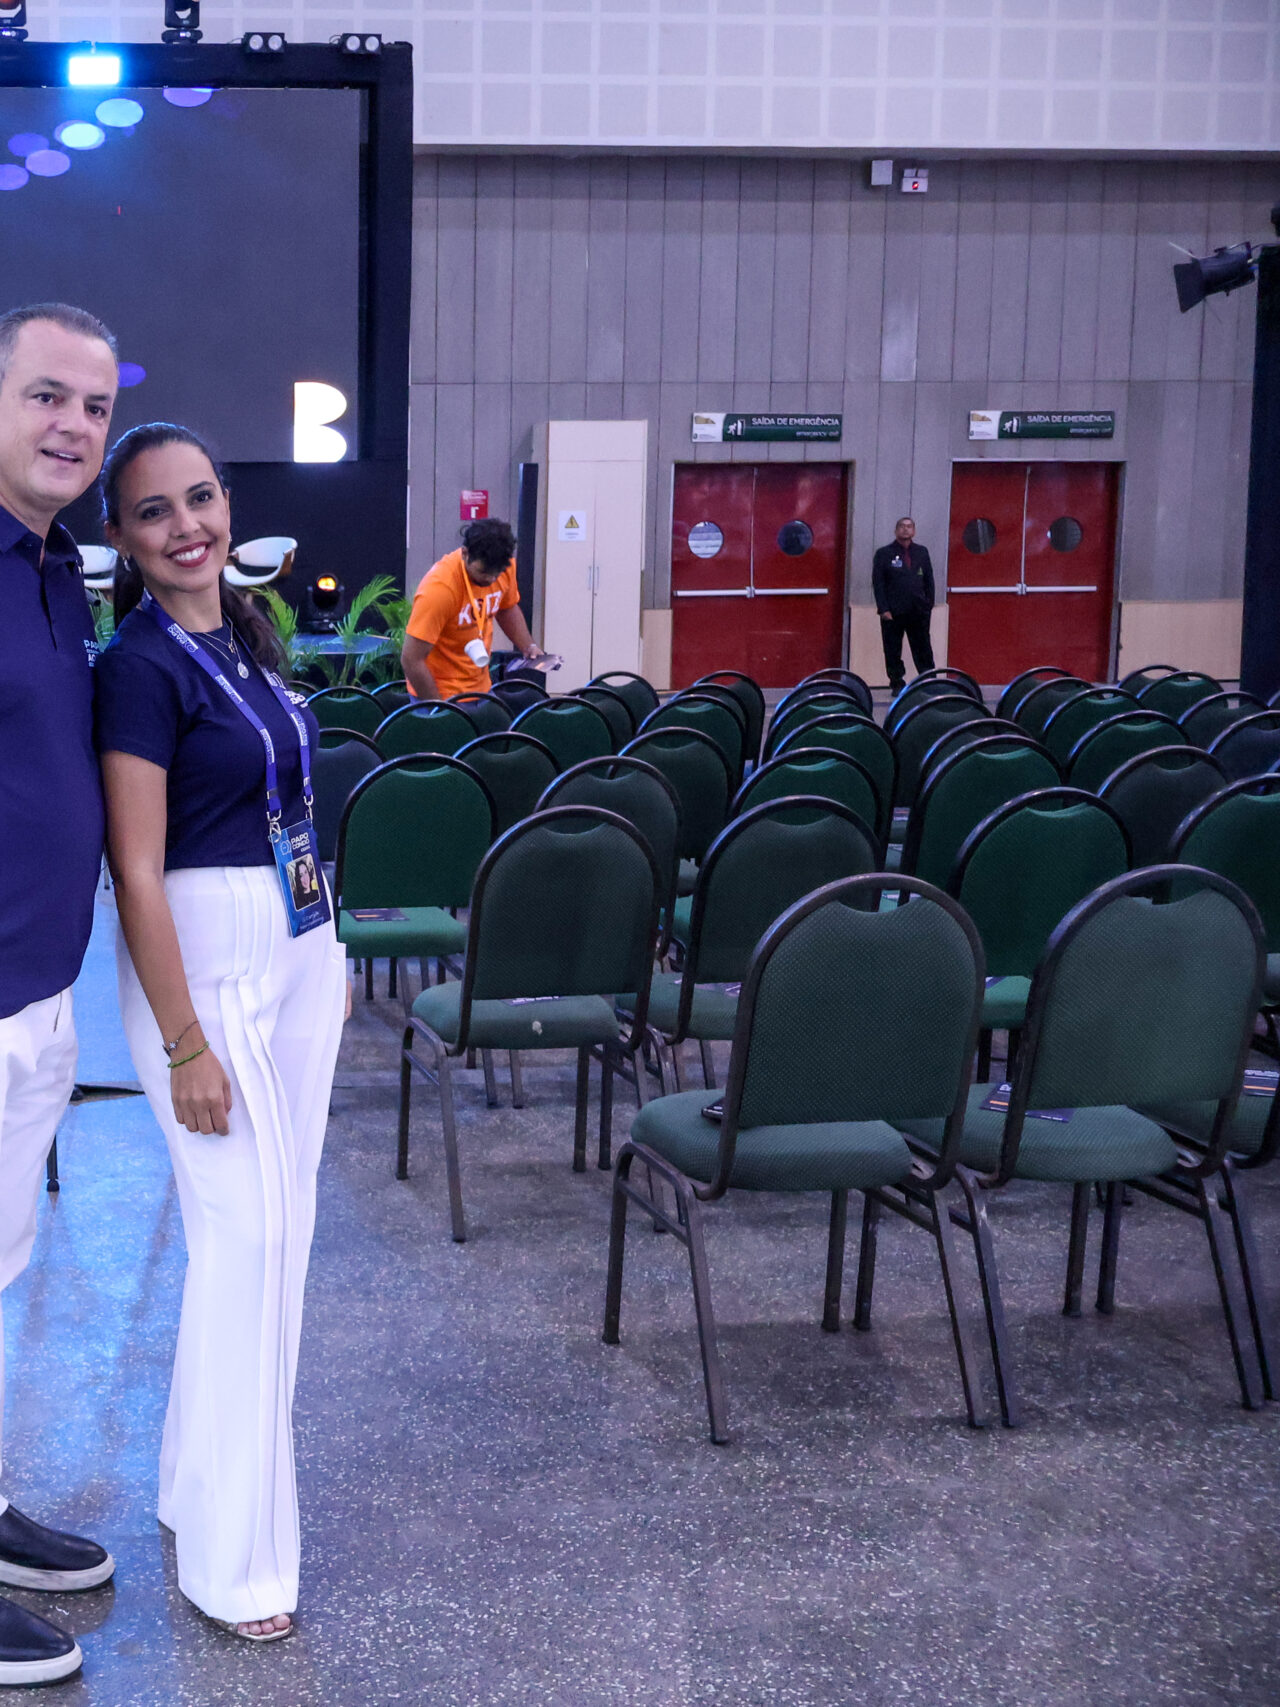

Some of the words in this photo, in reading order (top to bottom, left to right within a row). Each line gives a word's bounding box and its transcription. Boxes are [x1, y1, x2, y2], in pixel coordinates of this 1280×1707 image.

[752, 416, 775, 425] SAÍDA
[777, 417, 788, 425] DE
[789, 416, 839, 425] EMERGÊNCIA
[1027, 414, 1050, 423] SAÍDA
[1063, 414, 1112, 423] EMERGÊNCIA
[291, 832, 308, 845] PAPO
